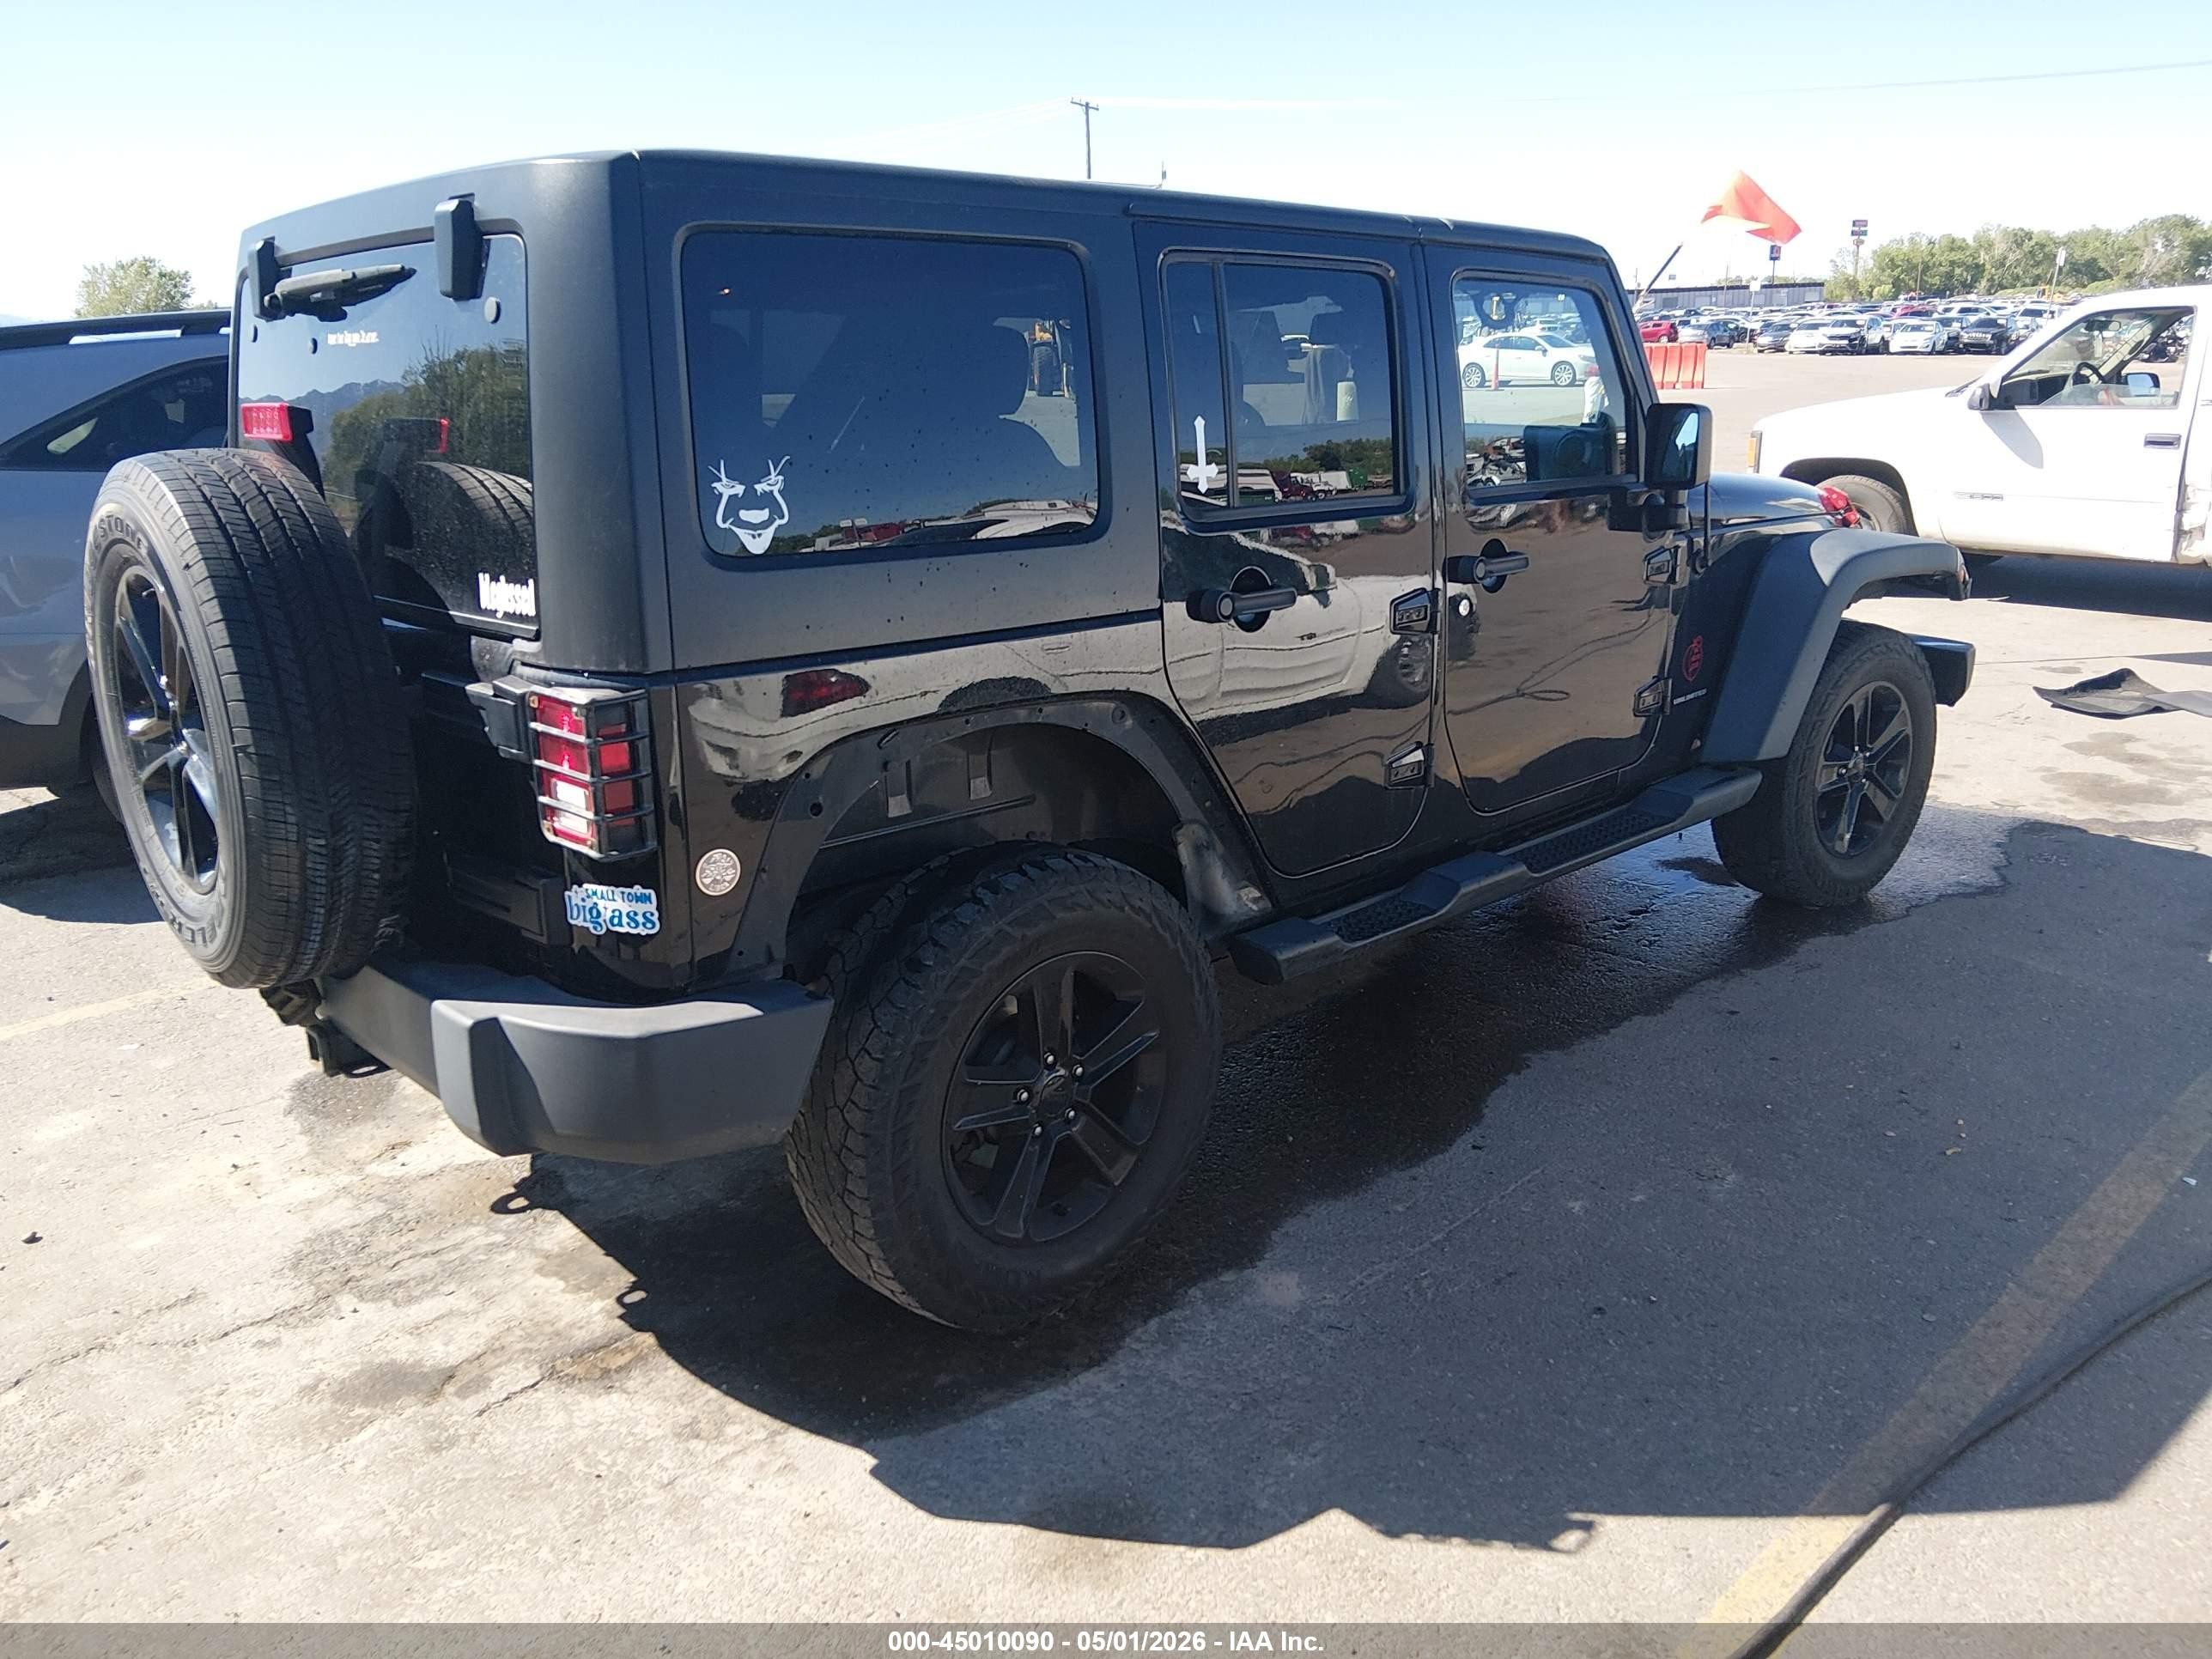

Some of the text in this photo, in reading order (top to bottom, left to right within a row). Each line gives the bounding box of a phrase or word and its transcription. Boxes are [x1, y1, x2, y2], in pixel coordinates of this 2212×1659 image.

[585, 887, 653, 905] SMALL TOWN
[568, 895, 657, 933] big ass
